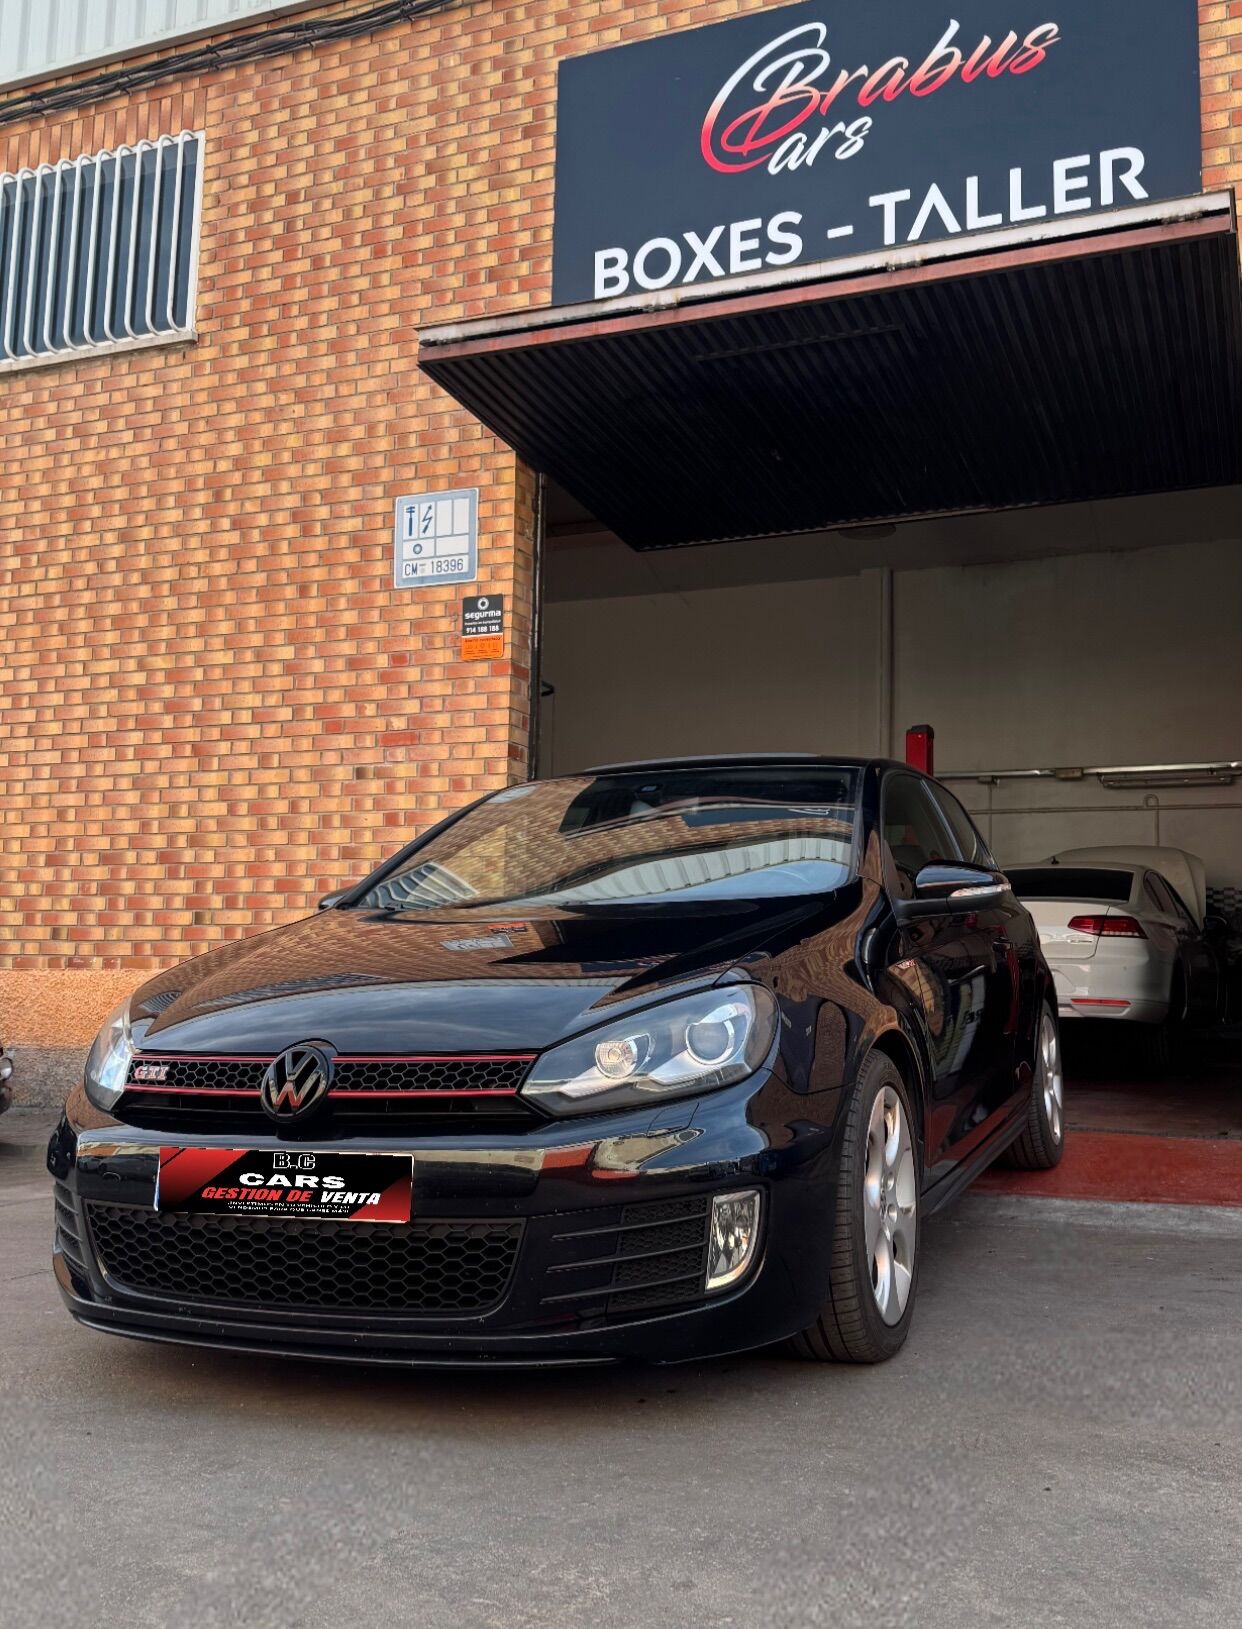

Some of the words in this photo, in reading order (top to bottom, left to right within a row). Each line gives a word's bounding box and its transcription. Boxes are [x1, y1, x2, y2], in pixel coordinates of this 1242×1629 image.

[721, 19, 1061, 156] Brabus
[594, 211, 803, 299] BOXES
[869, 147, 1149, 246] TALLER
[431, 559, 464, 573] 18396
[464, 610, 501, 620] segurma
[134, 1065, 170, 1081] GTI
[239, 1172, 346, 1189] CARS
[201, 1187, 283, 1201] GESTION
[285, 1190, 314, 1202] DE
[320, 1191, 381, 1206] VENTA
